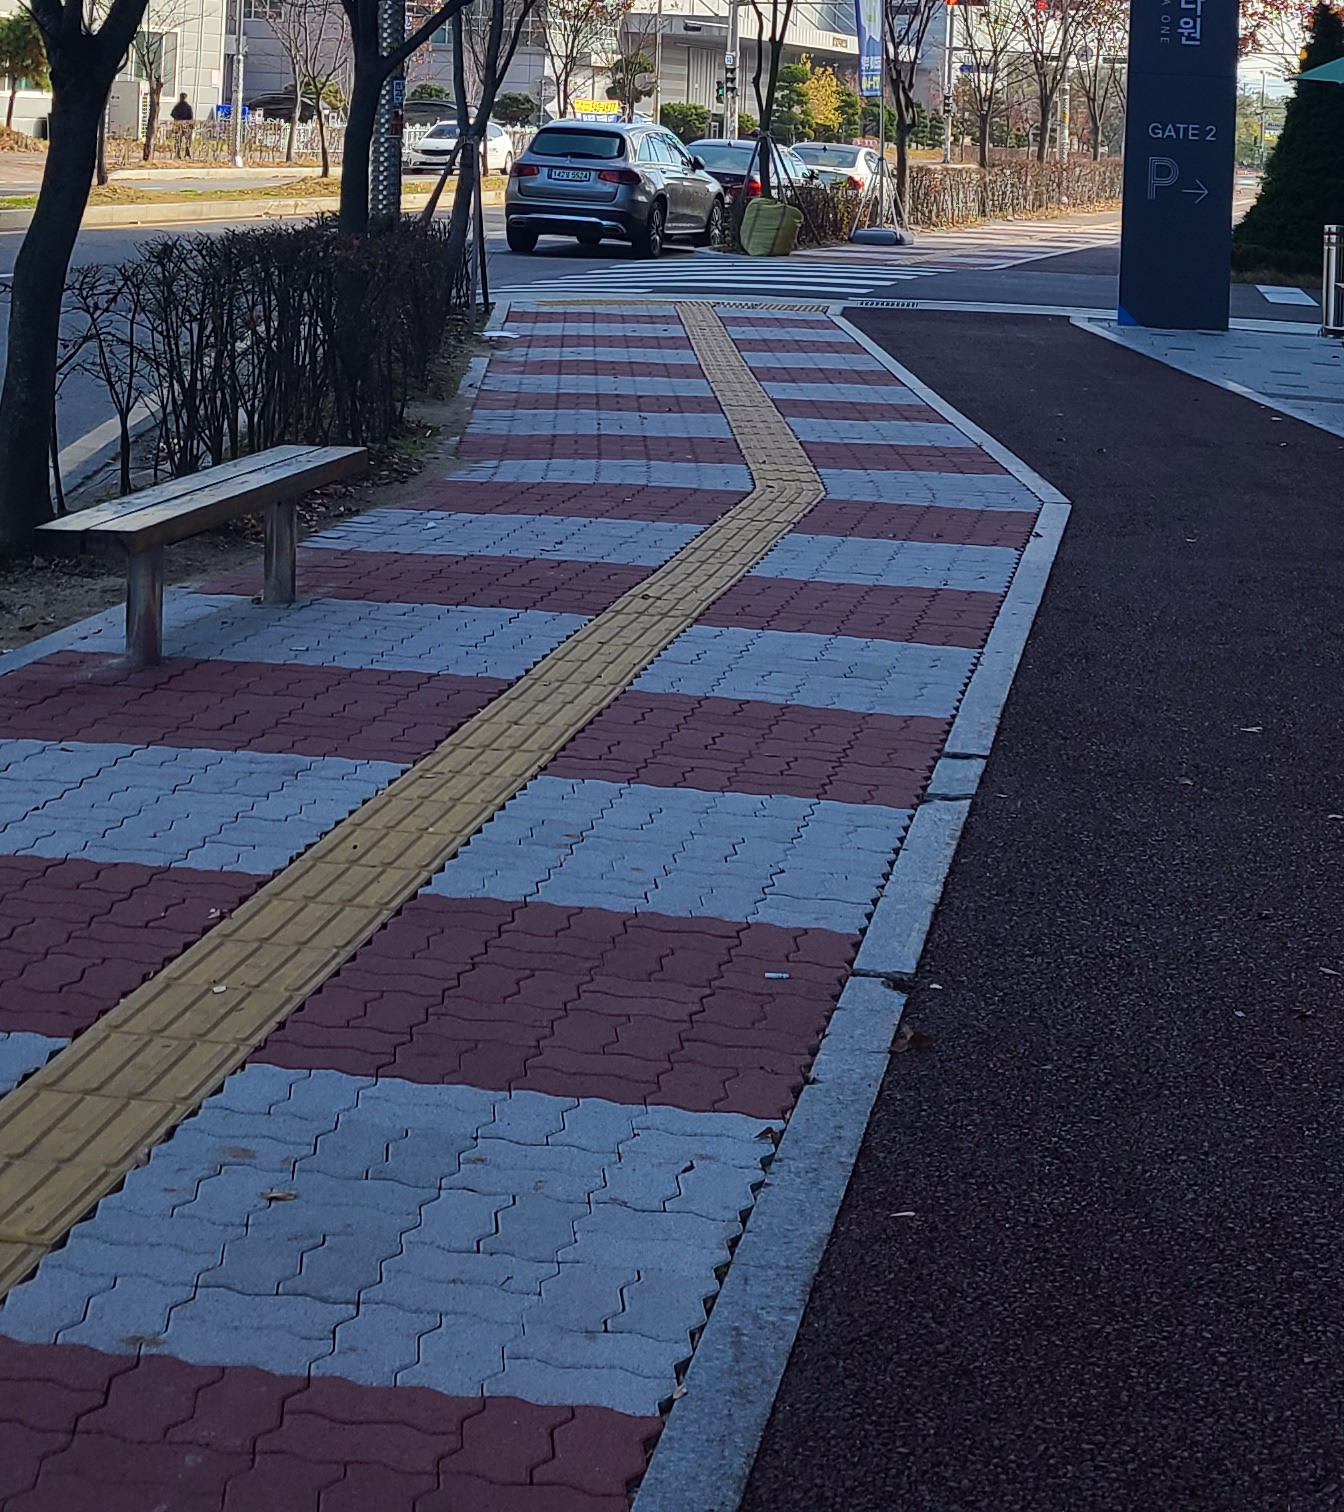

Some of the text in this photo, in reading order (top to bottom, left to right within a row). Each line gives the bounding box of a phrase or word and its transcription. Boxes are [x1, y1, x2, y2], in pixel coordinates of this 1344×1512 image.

[1160, 15, 1171, 44] ONE
[1148, 122, 1217, 142] GATE 2
[1147, 156, 1179, 201] P
